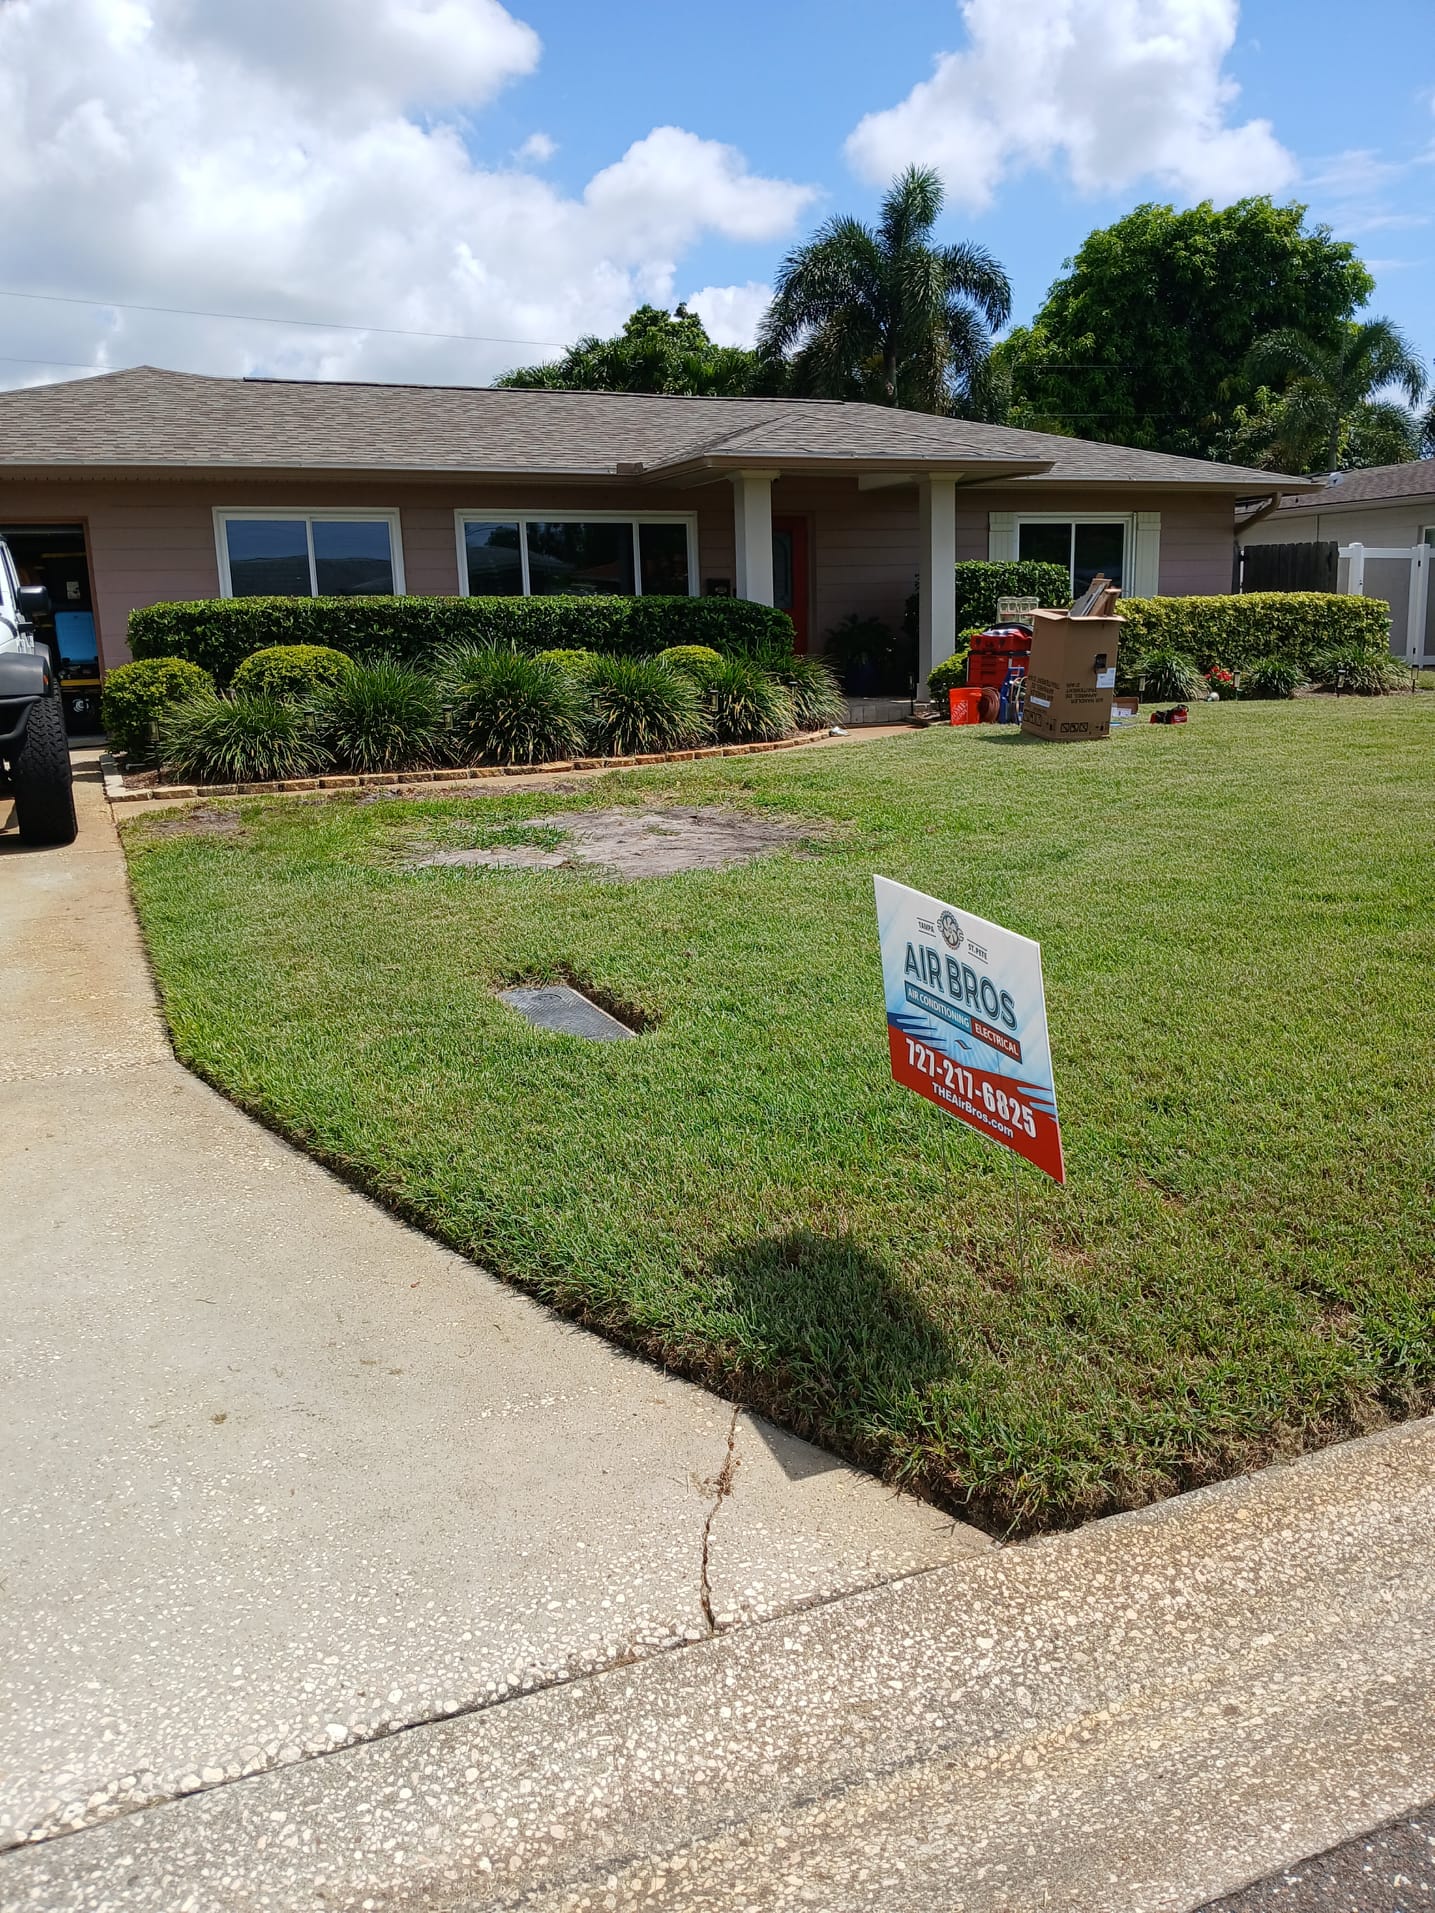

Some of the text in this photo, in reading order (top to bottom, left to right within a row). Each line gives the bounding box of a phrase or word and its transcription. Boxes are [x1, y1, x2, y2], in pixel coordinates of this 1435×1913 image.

[918, 921, 935, 933] TAMPA
[904, 942, 1018, 1031] AIR BROS
[908, 988, 970, 1028] AIR CONDITIONING
[974, 1023, 1019, 1056] ELECTRICAL
[905, 1037, 1037, 1139] 727-217-6825
[932, 1082, 1014, 1138] THEAirBros.com
